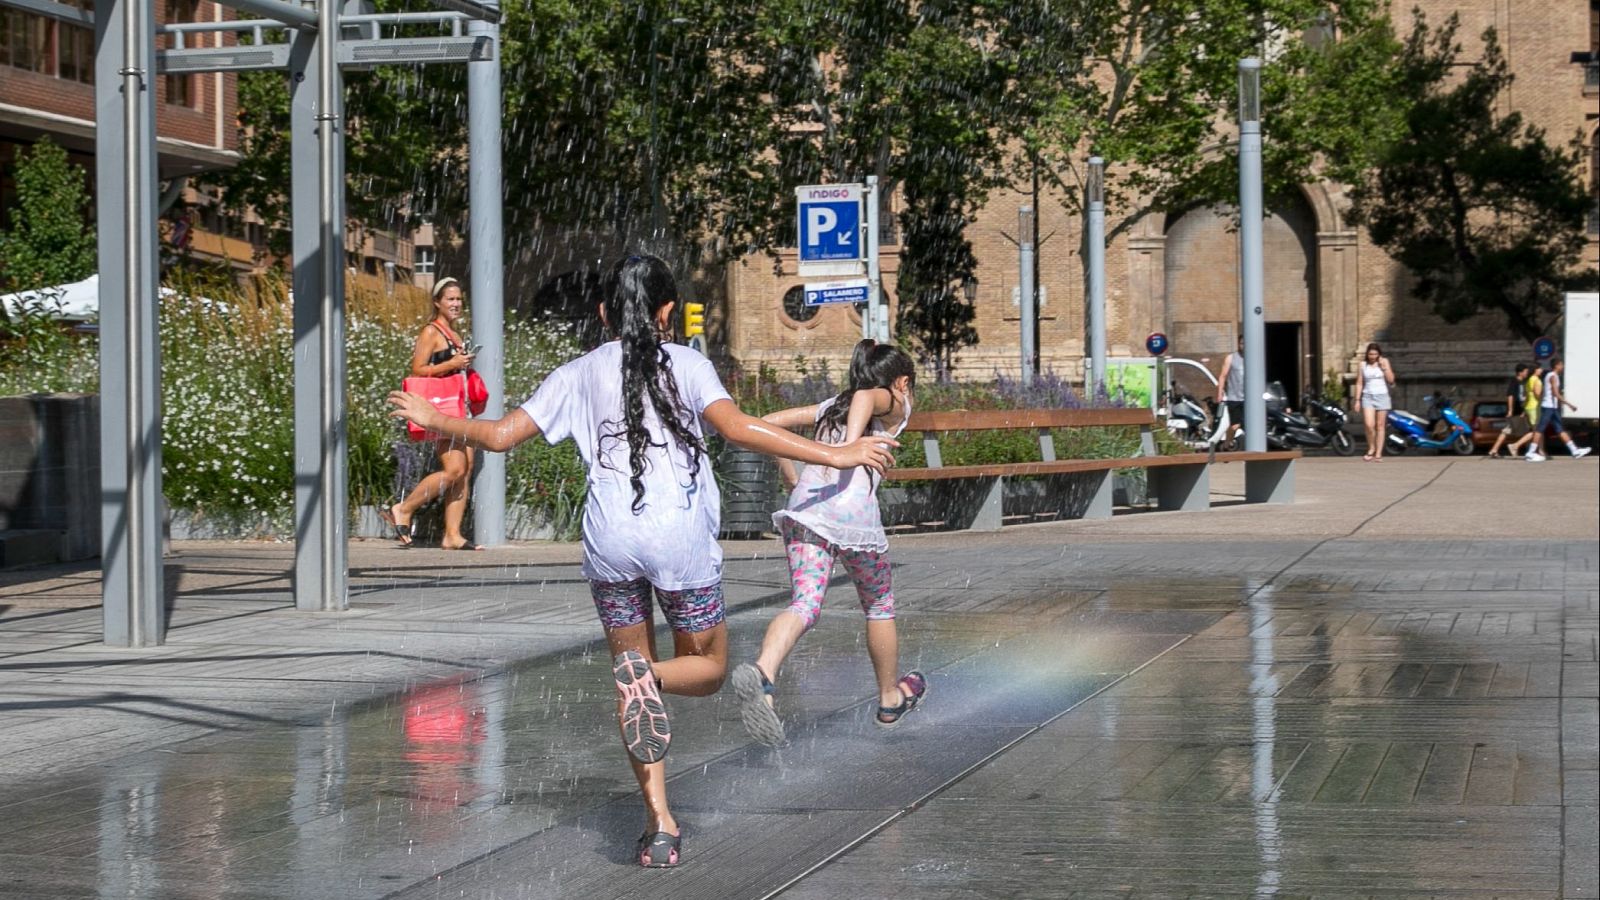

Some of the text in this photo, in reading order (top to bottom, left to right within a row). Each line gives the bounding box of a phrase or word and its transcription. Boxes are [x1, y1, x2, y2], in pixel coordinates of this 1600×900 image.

[809, 189, 849, 199] INDIGO
[808, 207, 838, 246] P
[808, 292, 818, 304] P
[823, 288, 864, 298] SALAMERO
